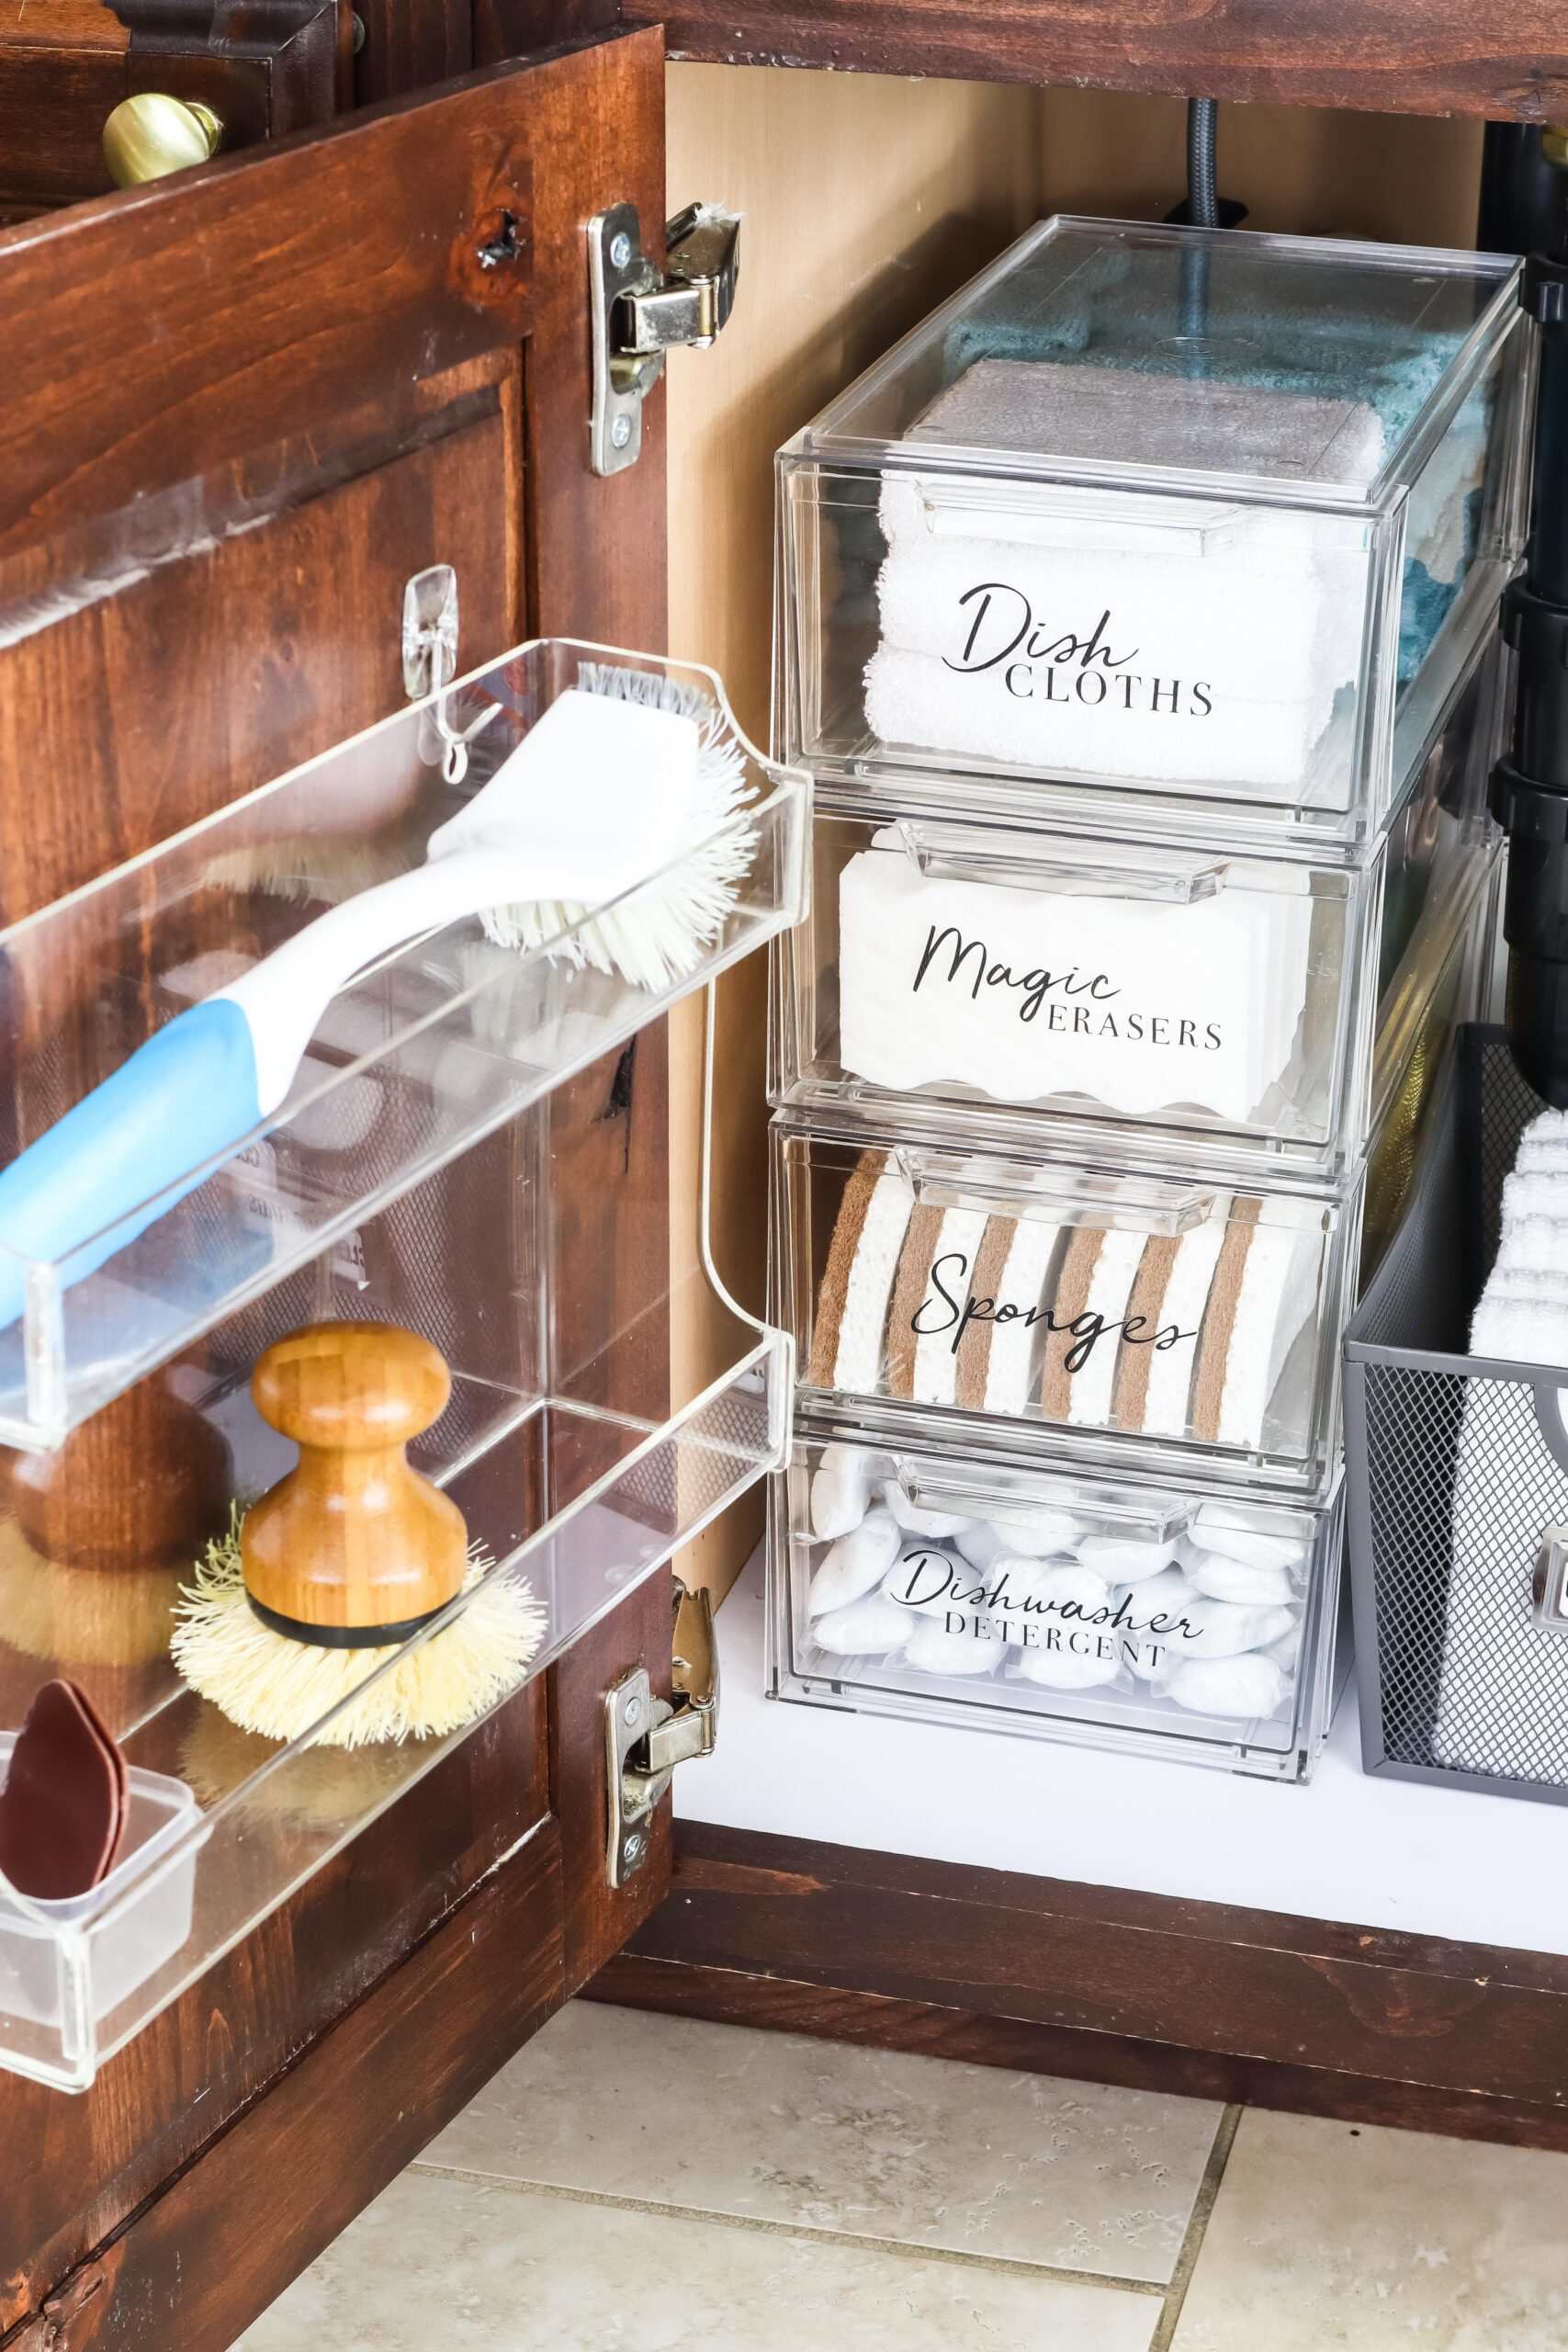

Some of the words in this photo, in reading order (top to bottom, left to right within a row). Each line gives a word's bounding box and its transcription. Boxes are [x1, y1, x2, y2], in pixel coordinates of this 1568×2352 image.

[942, 582, 1139, 673] Dish
[1005, 663, 1213, 717] CLOTHS
[912, 925, 1122, 1023] Magic
[1047, 1004, 1223, 1050] ERASERS
[910, 1253, 1198, 1374] Sponges
[889, 1550, 1204, 1639] Dishwasher
[944, 1611, 1166, 1667] DETERGENT
